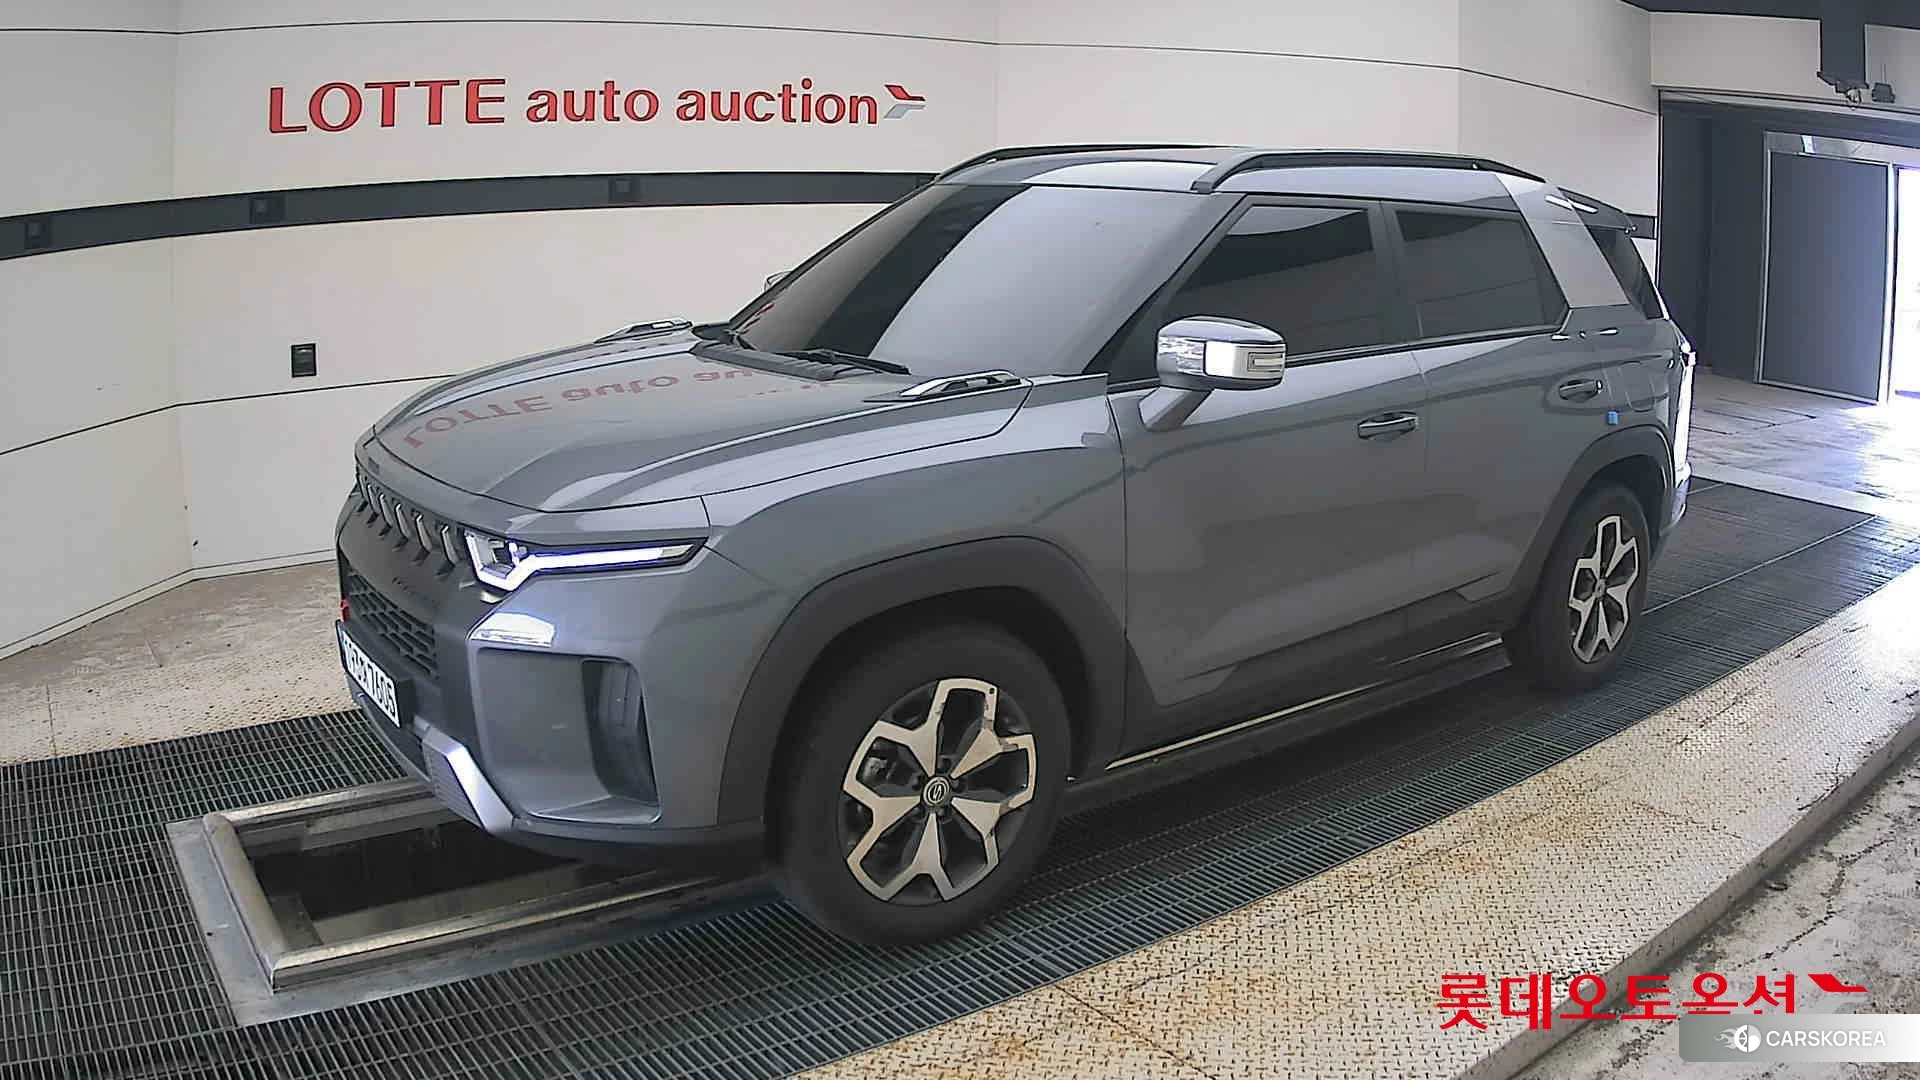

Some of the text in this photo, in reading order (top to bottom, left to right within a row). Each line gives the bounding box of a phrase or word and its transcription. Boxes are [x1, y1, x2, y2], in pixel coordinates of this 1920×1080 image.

[268, 78, 879, 134] LOTTE auto auction
